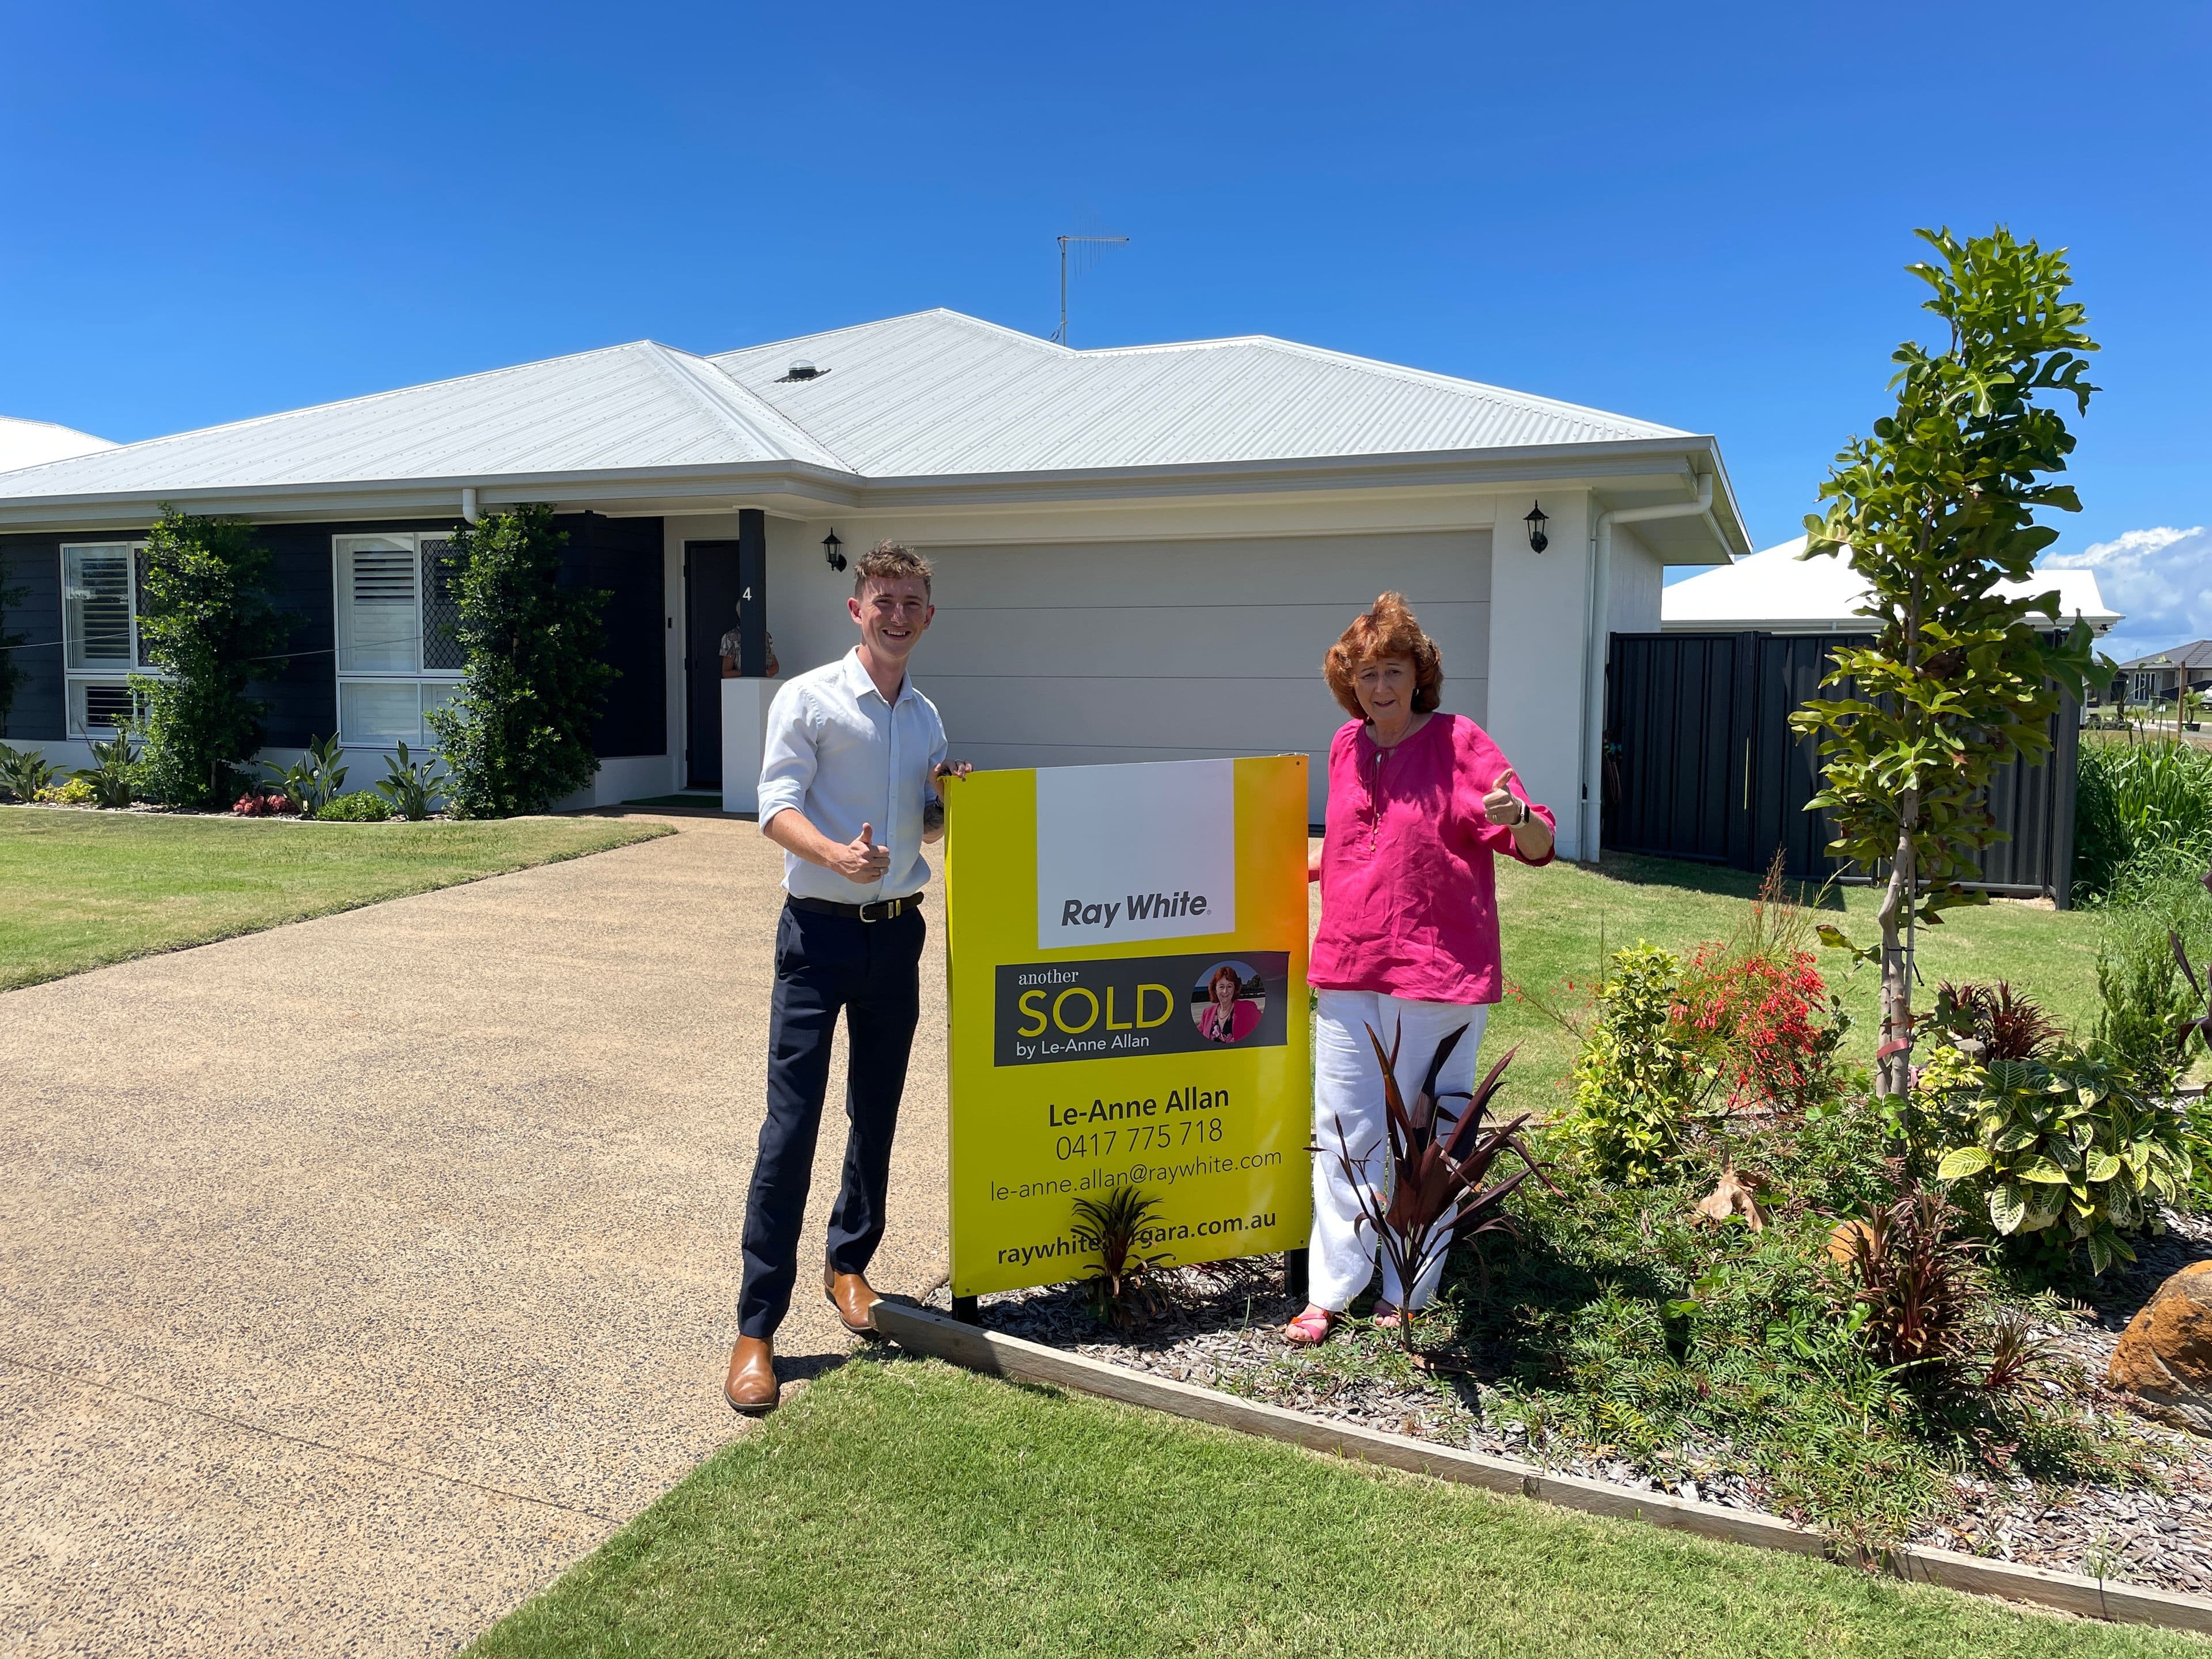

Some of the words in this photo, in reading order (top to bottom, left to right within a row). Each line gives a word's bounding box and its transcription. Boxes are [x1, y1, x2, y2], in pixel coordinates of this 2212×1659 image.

[743, 586, 752, 601] 4
[1061, 900, 1121, 928] Ray
[1127, 891, 1207, 921] White
[1018, 969, 1079, 985] another
[1017, 984, 1174, 1037] SOLD
[1017, 1041, 1035, 1059] by
[1041, 1039, 1106, 1054] Le-Anne
[1111, 1033, 1149, 1048] Allan
[1050, 1098, 1157, 1127] Le-Anne
[1165, 1086, 1229, 1114] Allan
[1056, 1131, 1116, 1161] 0417
[1127, 1124, 1171, 1152] 775
[1180, 1118, 1223, 1145] 718
[991, 1151, 1282, 1202] le-anne.allan@raywhite.com
[998, 1213, 1277, 1266] raywhitergara.com.au
